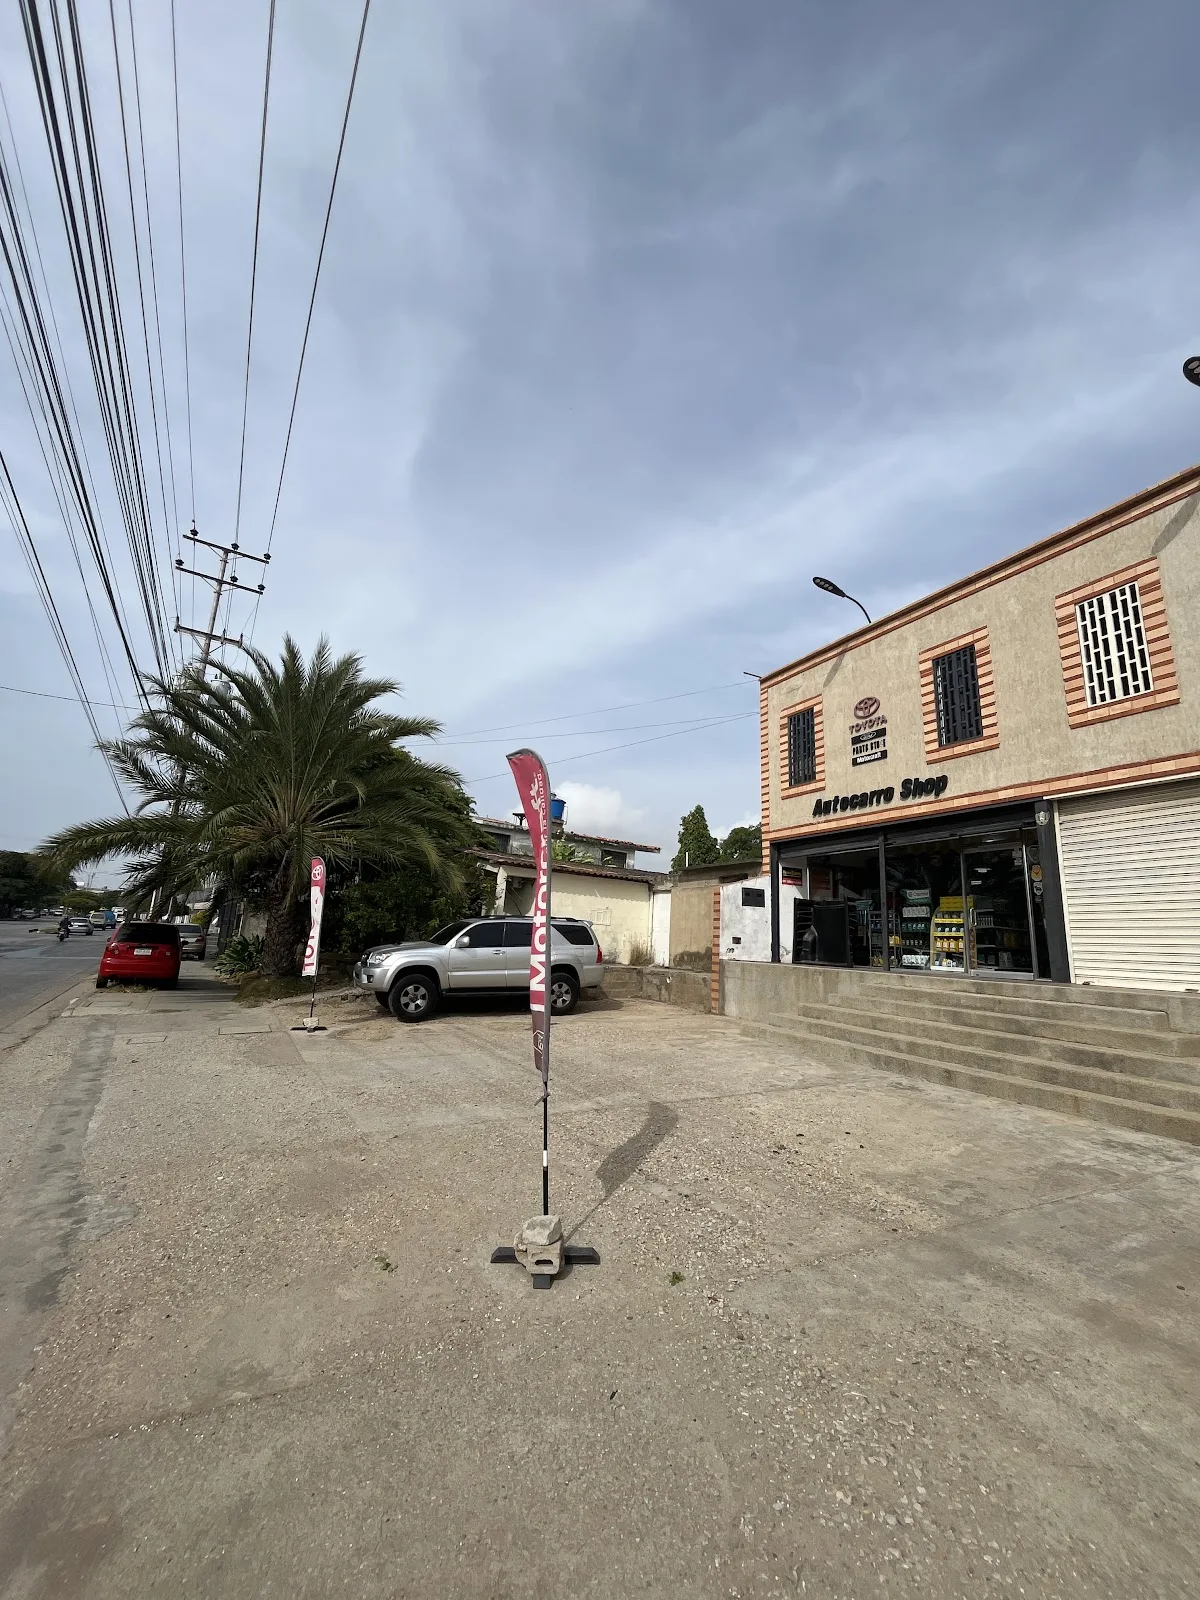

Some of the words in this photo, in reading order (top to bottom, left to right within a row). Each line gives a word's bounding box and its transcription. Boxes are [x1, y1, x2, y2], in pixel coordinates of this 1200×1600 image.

[848, 715, 887, 735] TOYOTA
[853, 743, 869, 756] PARTS
[870, 738, 886, 752] STOE
[812, 786, 895, 818] Autocarro
[900, 774, 949, 800] Shop
